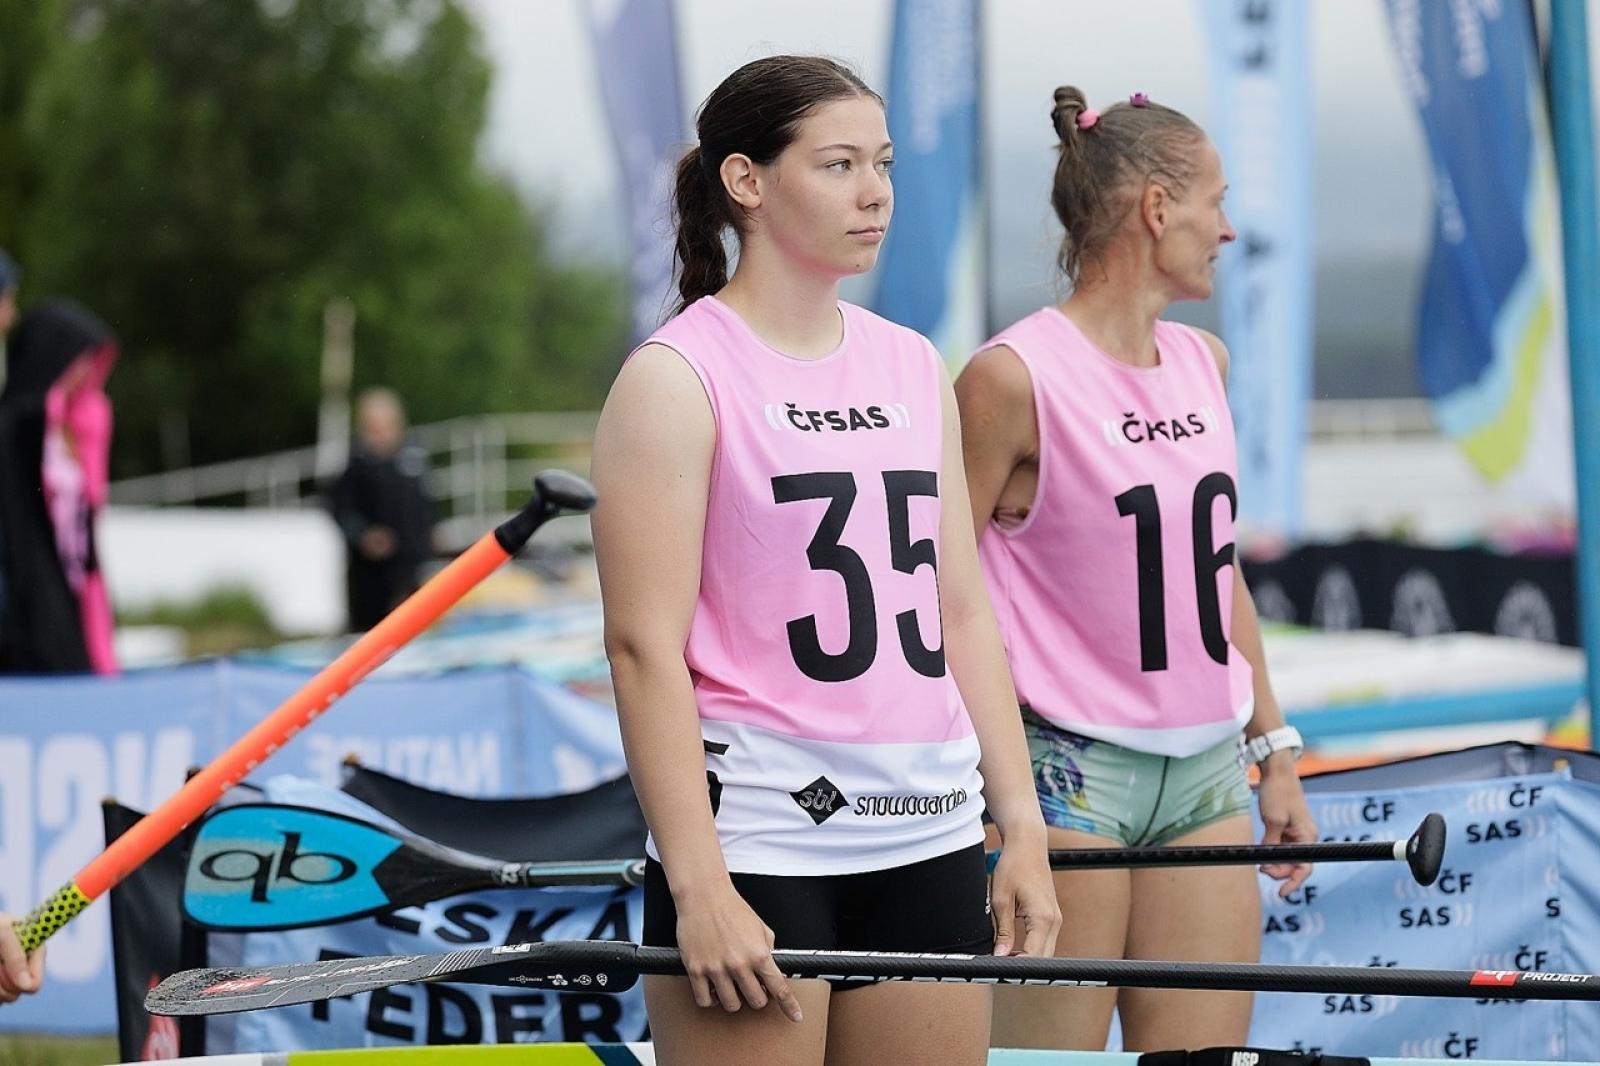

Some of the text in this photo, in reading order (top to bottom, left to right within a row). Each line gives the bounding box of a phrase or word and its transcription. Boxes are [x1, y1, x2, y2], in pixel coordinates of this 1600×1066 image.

[784, 402, 890, 432] ČFSAS
[771, 470, 945, 682] 35
[1114, 472, 1238, 672] 16
[1508, 783, 1543, 808] ČF
[1362, 797, 1395, 822] ČF
[1466, 820, 1522, 843] SAS
[1439, 869, 1473, 894] ČF
[1400, 906, 1450, 928] SAS
[1515, 945, 1548, 971] ČF
[1522, 971, 1593, 983] PROJECT
[1324, 995, 1373, 1014] SAS
[1444, 1033, 1479, 1059] ČF
